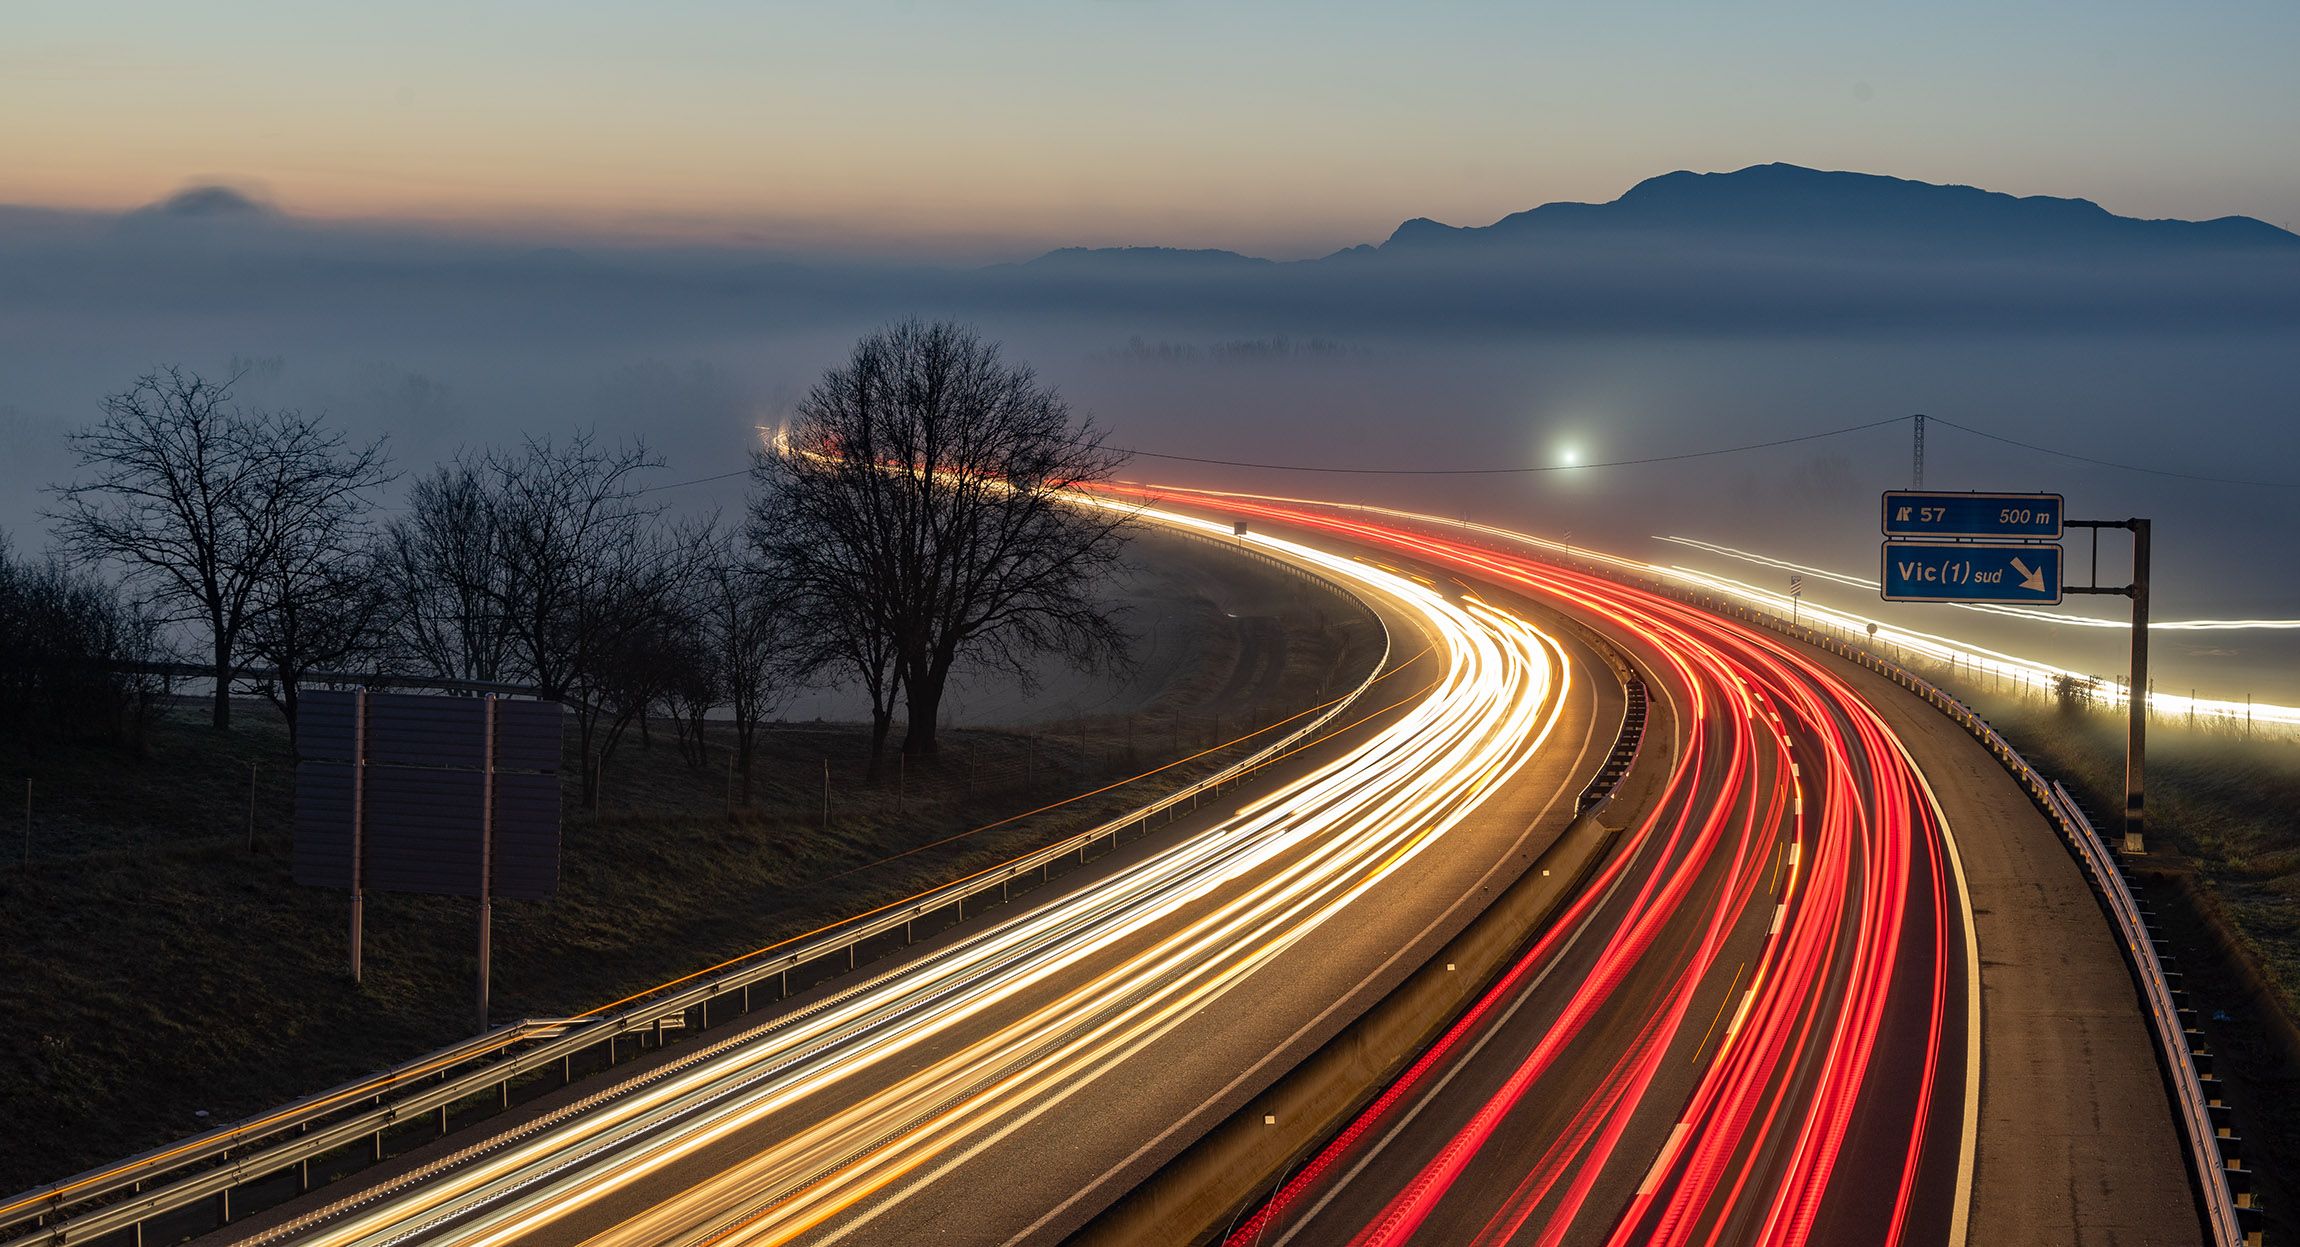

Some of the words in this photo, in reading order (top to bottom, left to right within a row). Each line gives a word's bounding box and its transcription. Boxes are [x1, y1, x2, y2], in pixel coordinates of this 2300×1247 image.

[1920, 507, 1945, 522] 57
[1999, 509, 2030, 524] 500
[2035, 512, 2050, 525] m
[1898, 562, 1937, 581] Vic
[1941, 560, 1970, 585] (1)
[1974, 569, 2002, 583] sud
